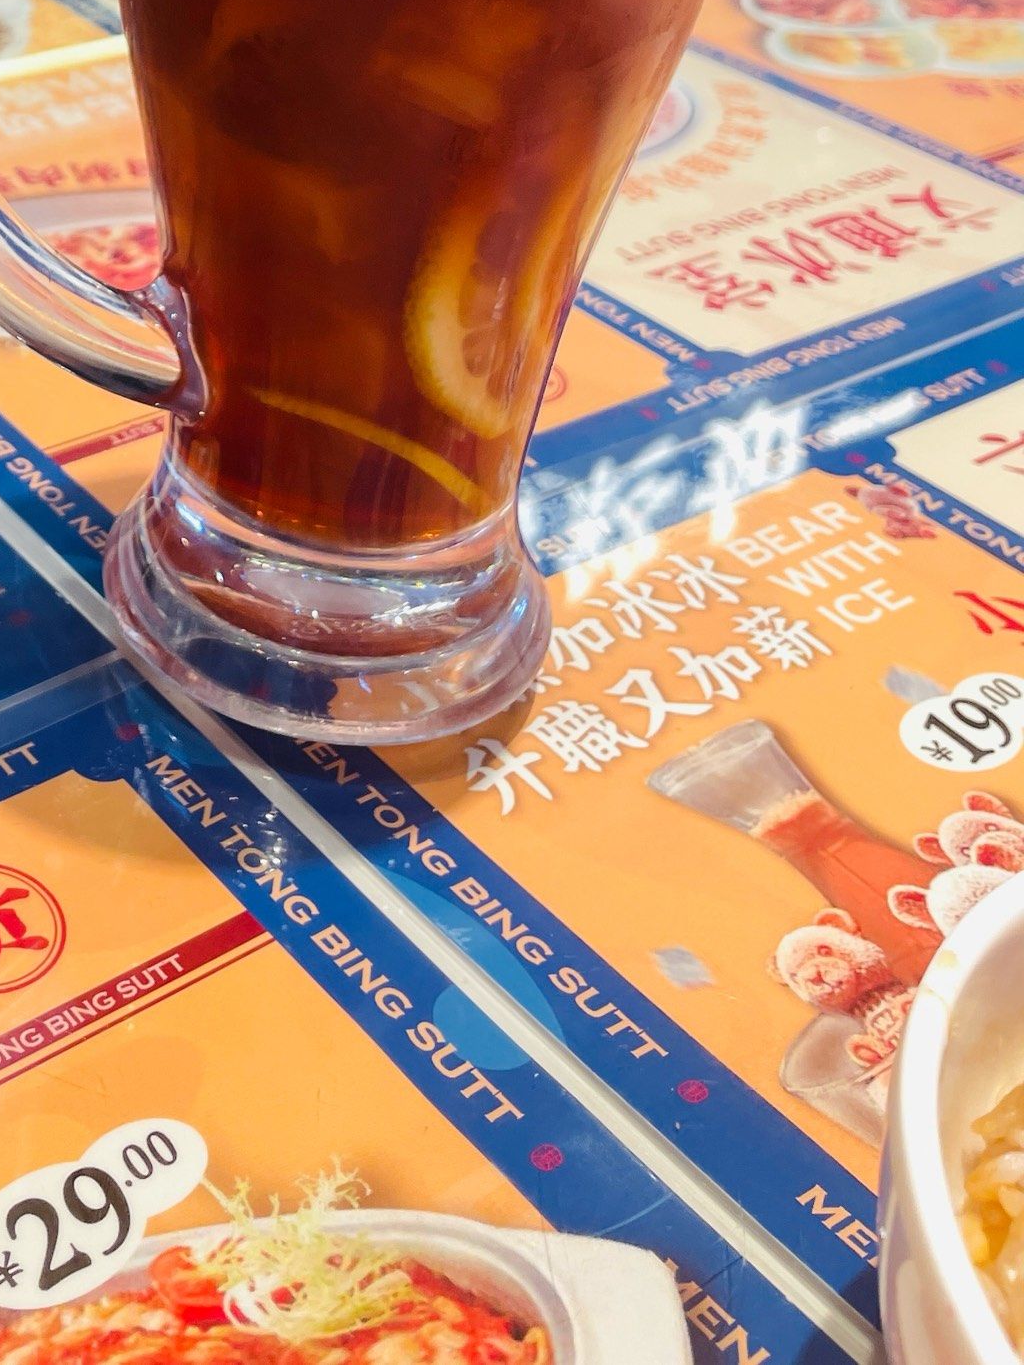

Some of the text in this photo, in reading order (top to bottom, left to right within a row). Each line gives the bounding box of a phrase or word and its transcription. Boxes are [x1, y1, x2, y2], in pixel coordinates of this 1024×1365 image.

[575, 286, 631, 327] TON
[5, 456, 76, 518] TONG
[725, 500, 863, 570] BEAR
[765, 529, 903, 598] WITH
[816, 576, 916, 634] ICE
[144, 754, 526, 1124] MEN TONG BING SUTT
[356, 784, 459, 877] TONG
[449, 877, 555, 966] BING
[547, 966, 670, 1060] SUTT
[44, 990, 117, 1037] BING
[115, 952, 186, 1000] SUTT
[794, 1183, 880, 1269] ME
